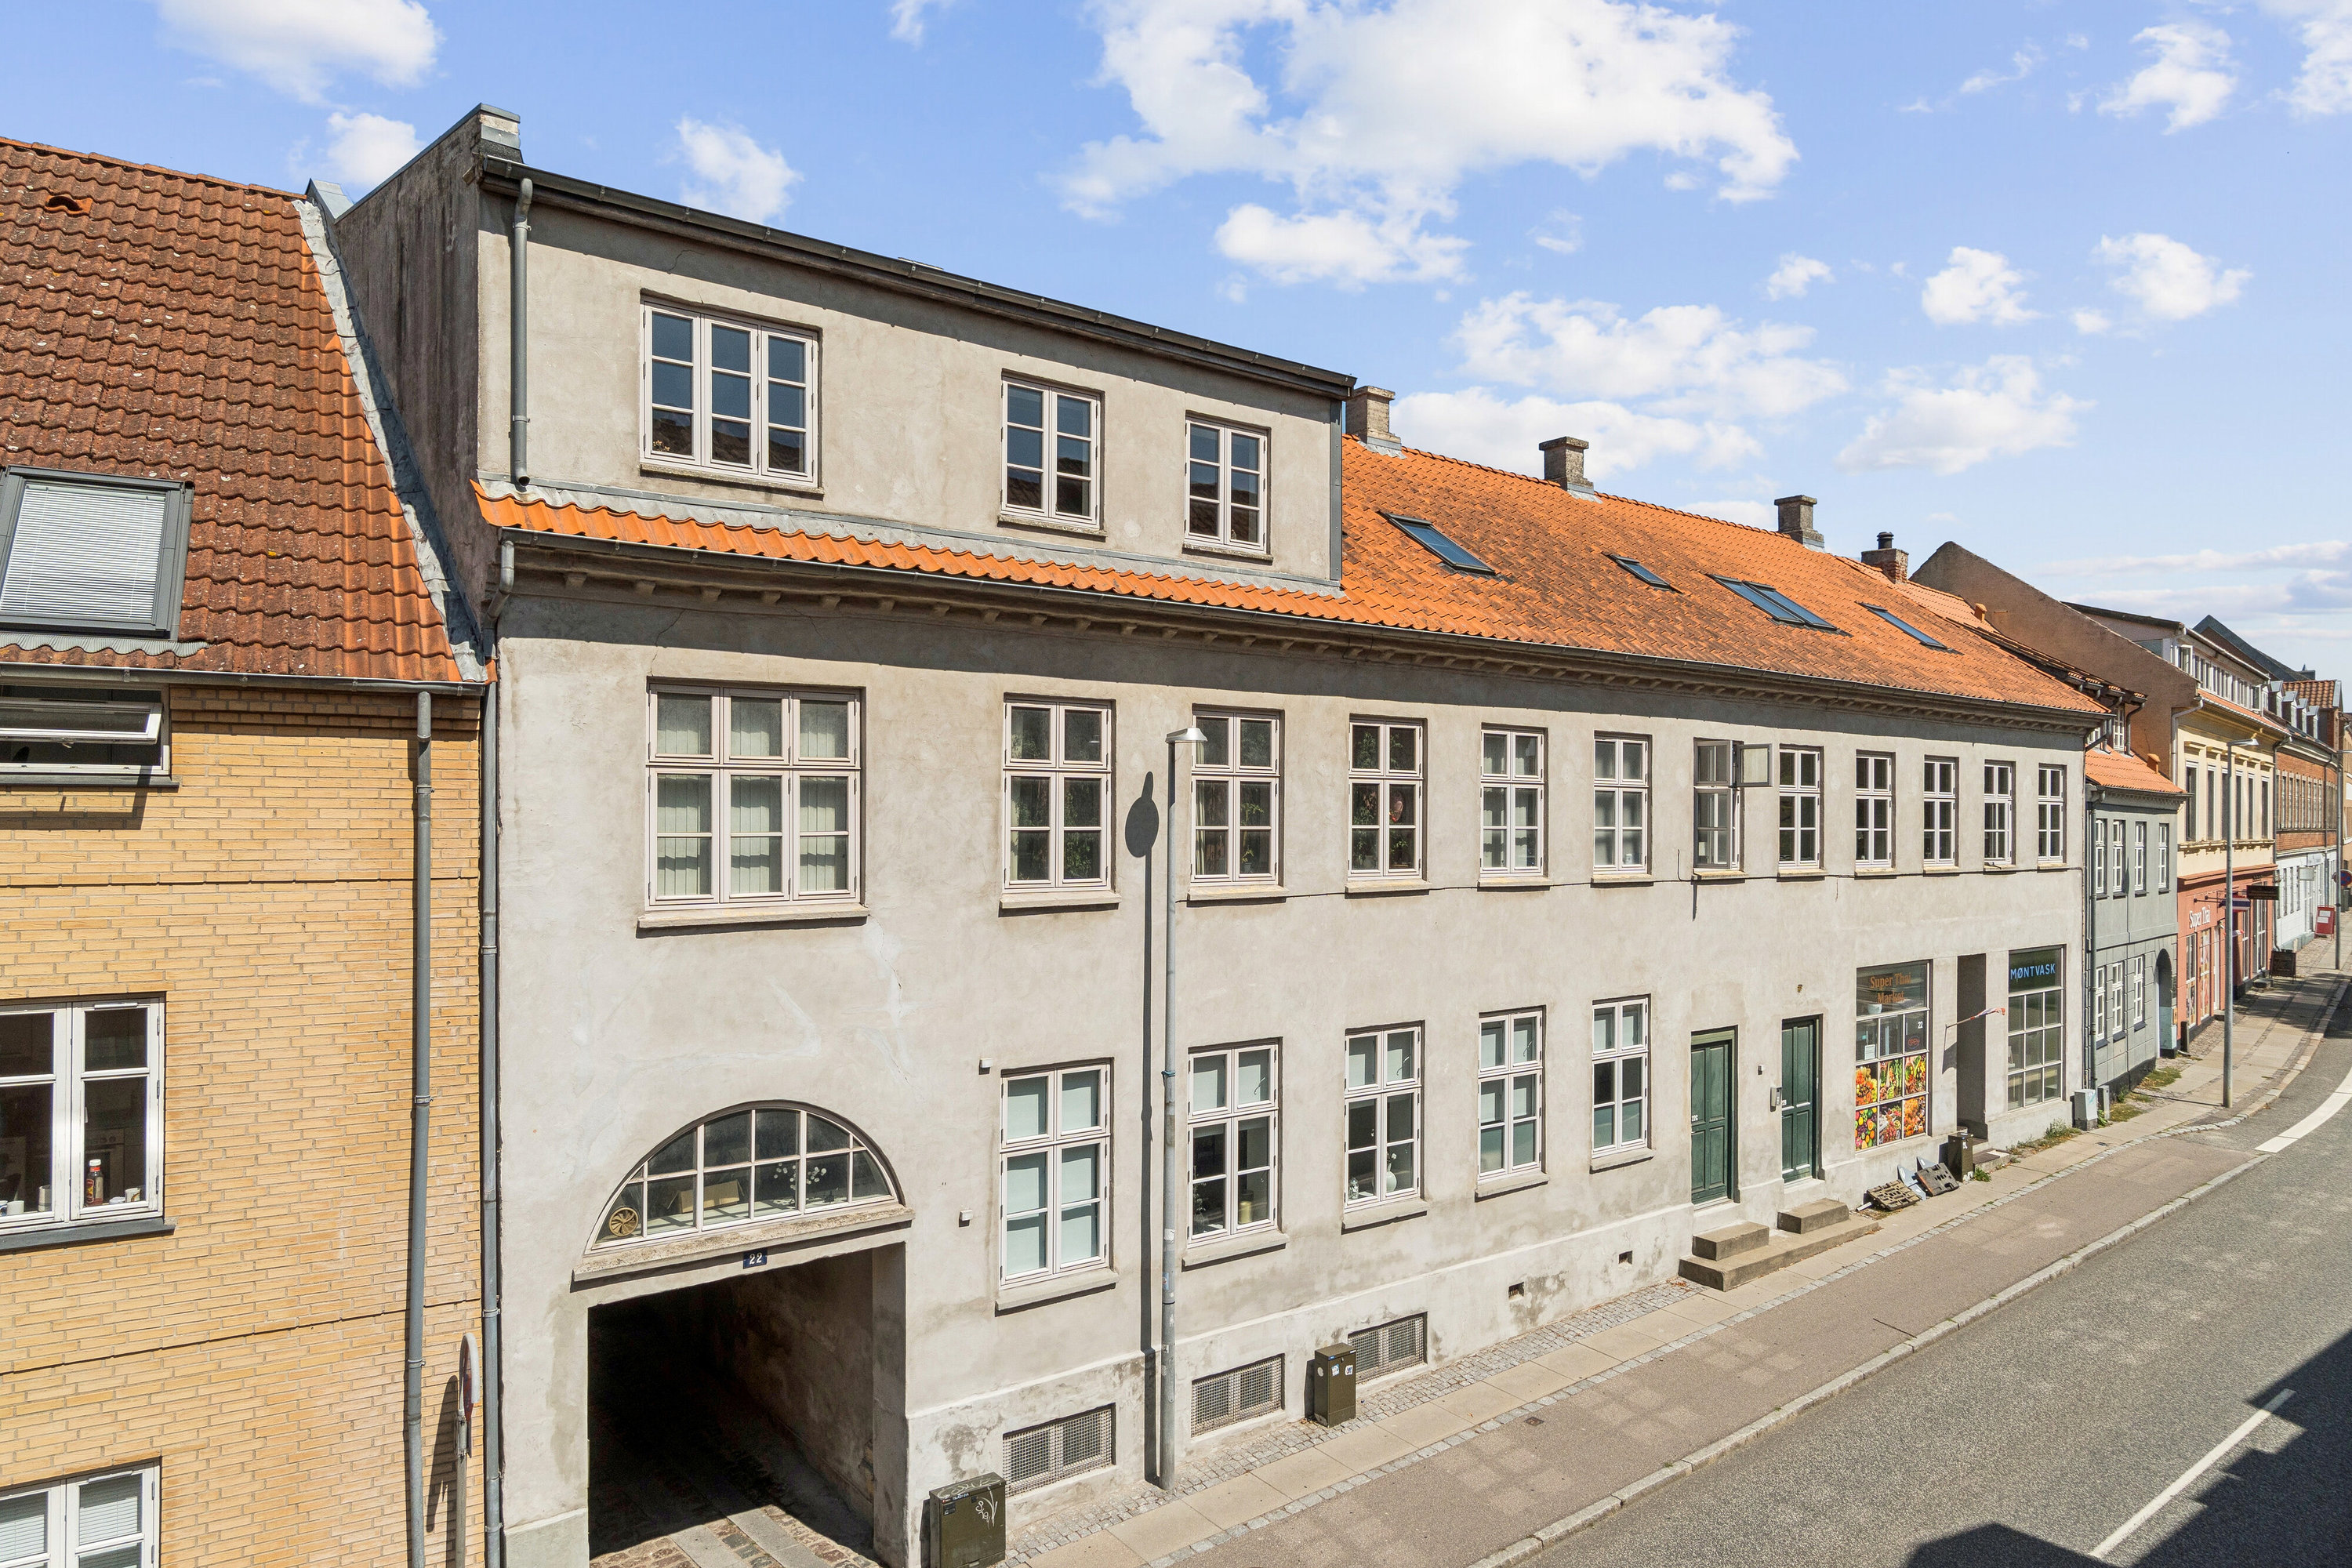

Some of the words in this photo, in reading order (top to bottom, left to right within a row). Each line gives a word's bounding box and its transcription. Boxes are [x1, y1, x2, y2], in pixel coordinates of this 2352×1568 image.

[2189, 910, 2201, 932] Super
[2010, 963, 2056, 979] MØNTVASK
[1870, 976, 1893, 990] Super
[1894, 972, 1911, 985] Thai
[1877, 990, 1904, 1004] Market
[1918, 1021, 1923, 1029] 22
[750, 1252, 763, 1265] 22
